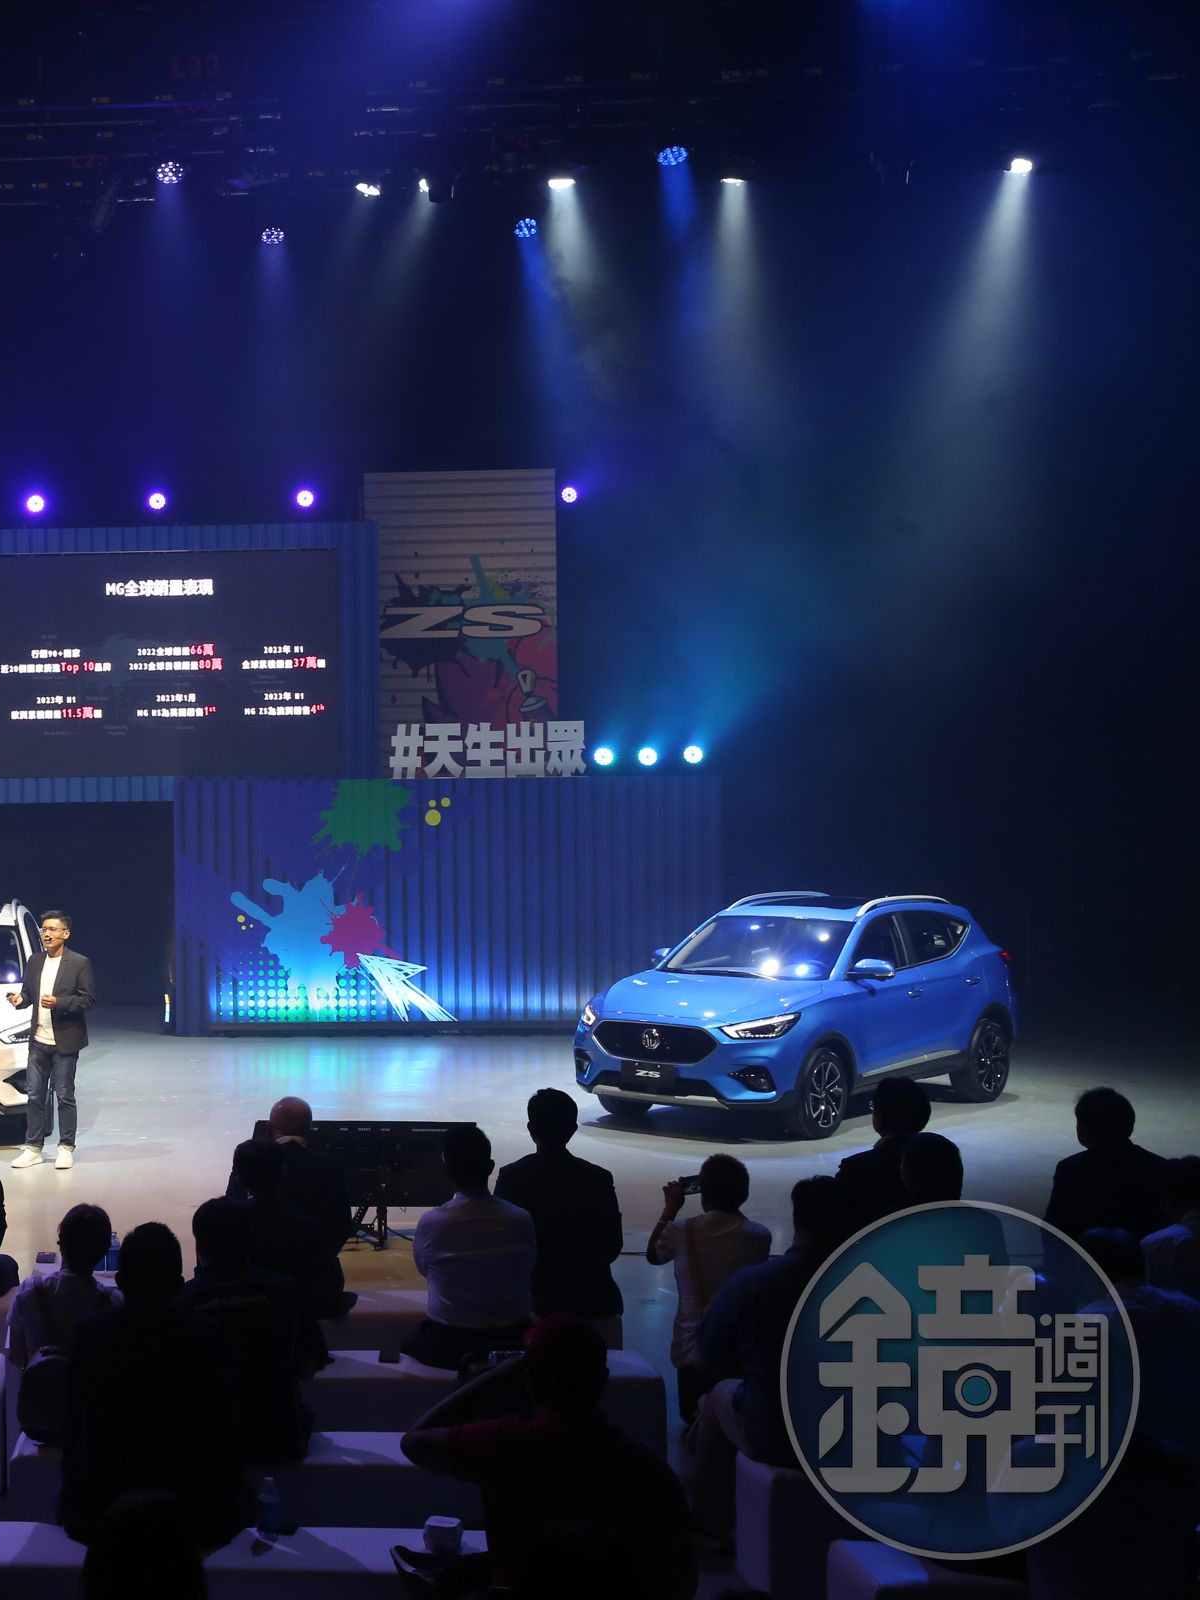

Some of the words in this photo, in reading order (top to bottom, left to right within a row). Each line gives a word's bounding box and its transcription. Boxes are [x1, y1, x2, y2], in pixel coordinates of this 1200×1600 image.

[379, 604, 547, 639] ZS
[389, 719, 588, 780] #天生出眾
[635, 1069, 661, 1078] ZS
